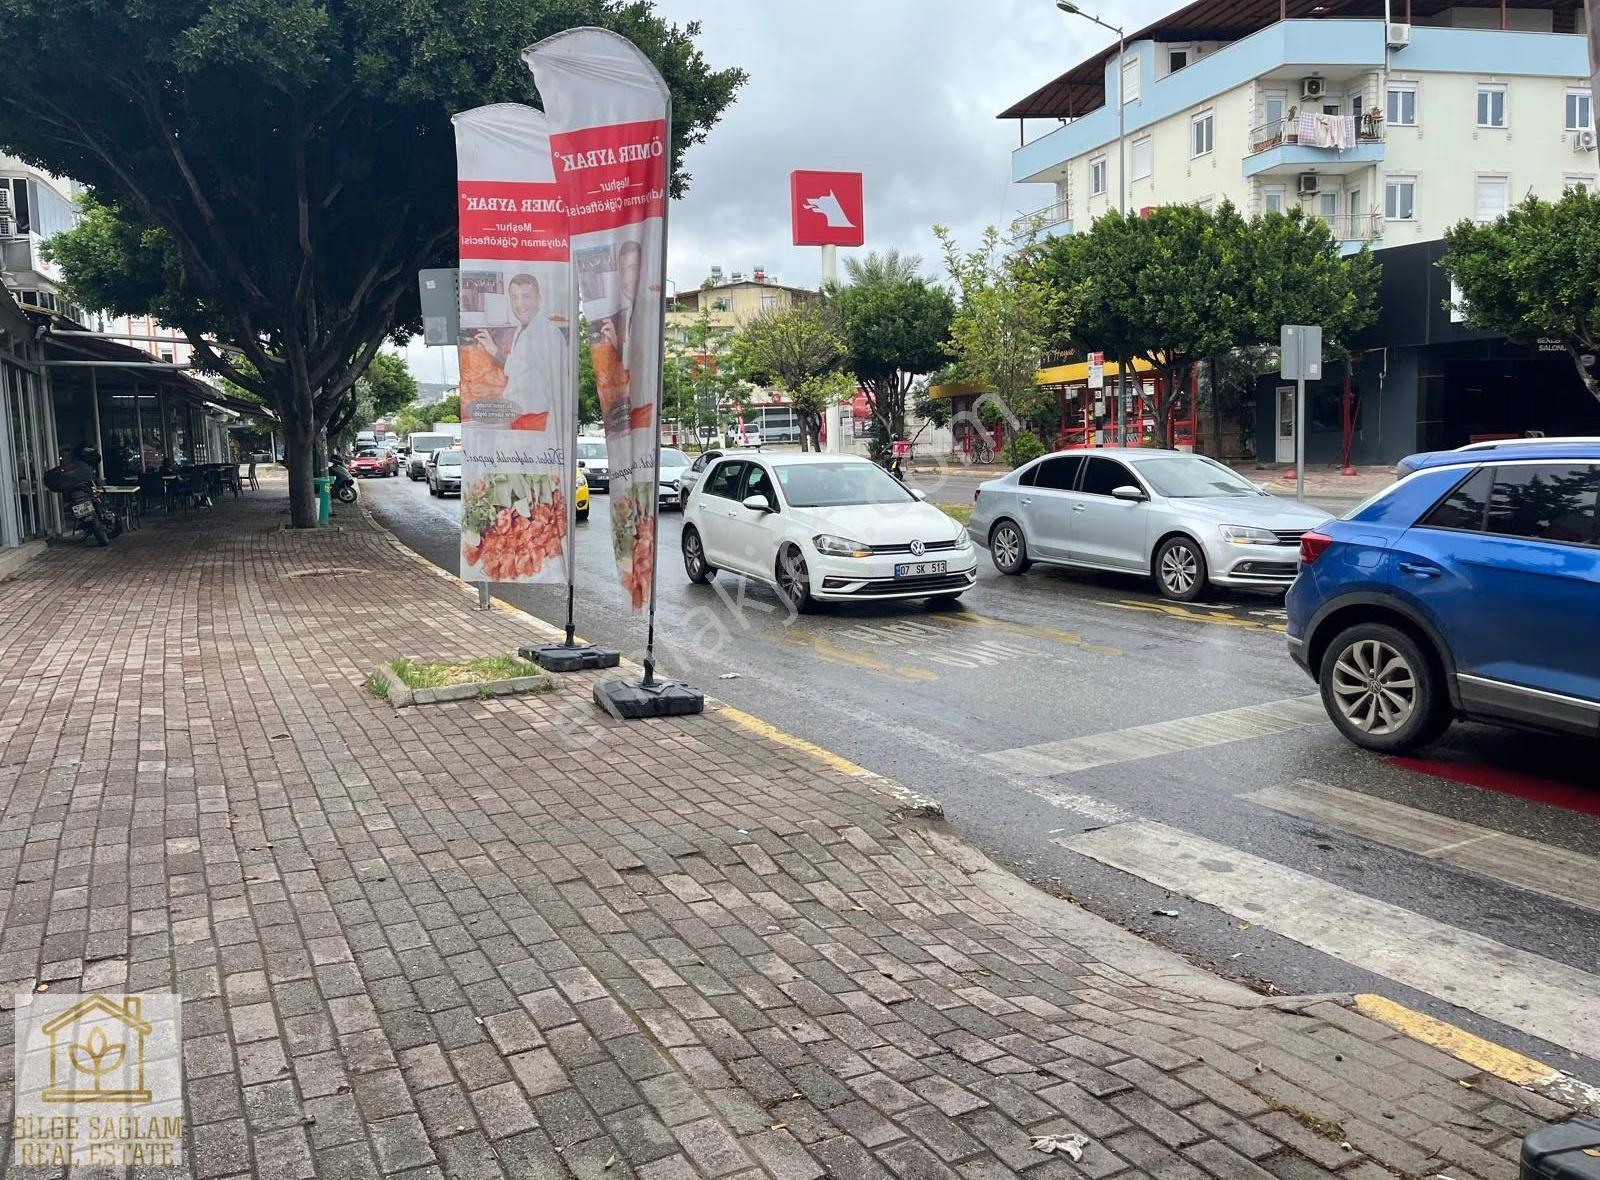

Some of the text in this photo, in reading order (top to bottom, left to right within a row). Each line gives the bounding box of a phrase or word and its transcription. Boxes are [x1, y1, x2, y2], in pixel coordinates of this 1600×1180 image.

[900, 562, 945, 576] 07 SK 513
